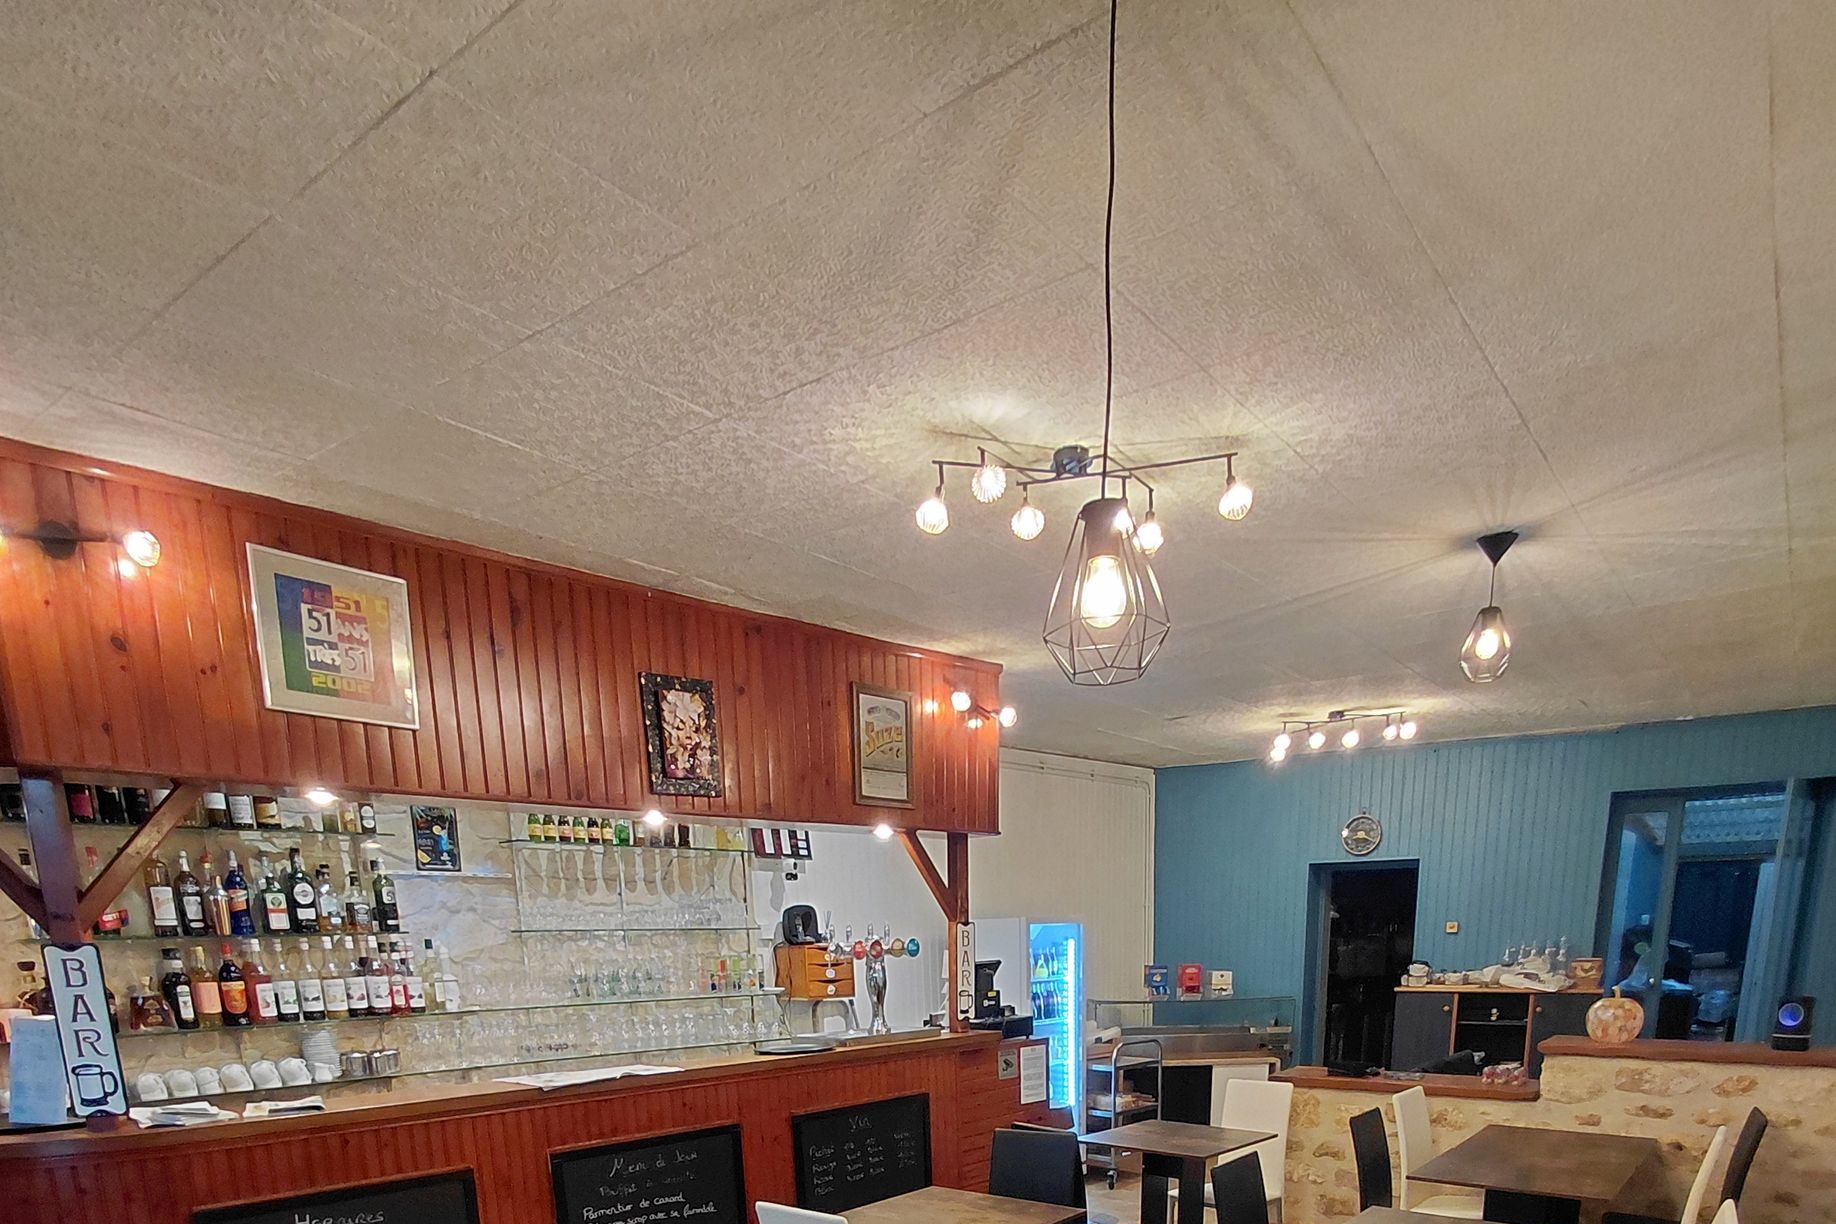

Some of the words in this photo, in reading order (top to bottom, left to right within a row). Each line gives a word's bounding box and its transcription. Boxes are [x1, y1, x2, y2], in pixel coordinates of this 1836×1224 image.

[307, 607, 332, 636] 51
[344, 647, 368, 674] 51
[311, 672, 372, 695] 2002
[961, 929, 972, 987] BAR
[61, 958, 109, 1058] BAR
